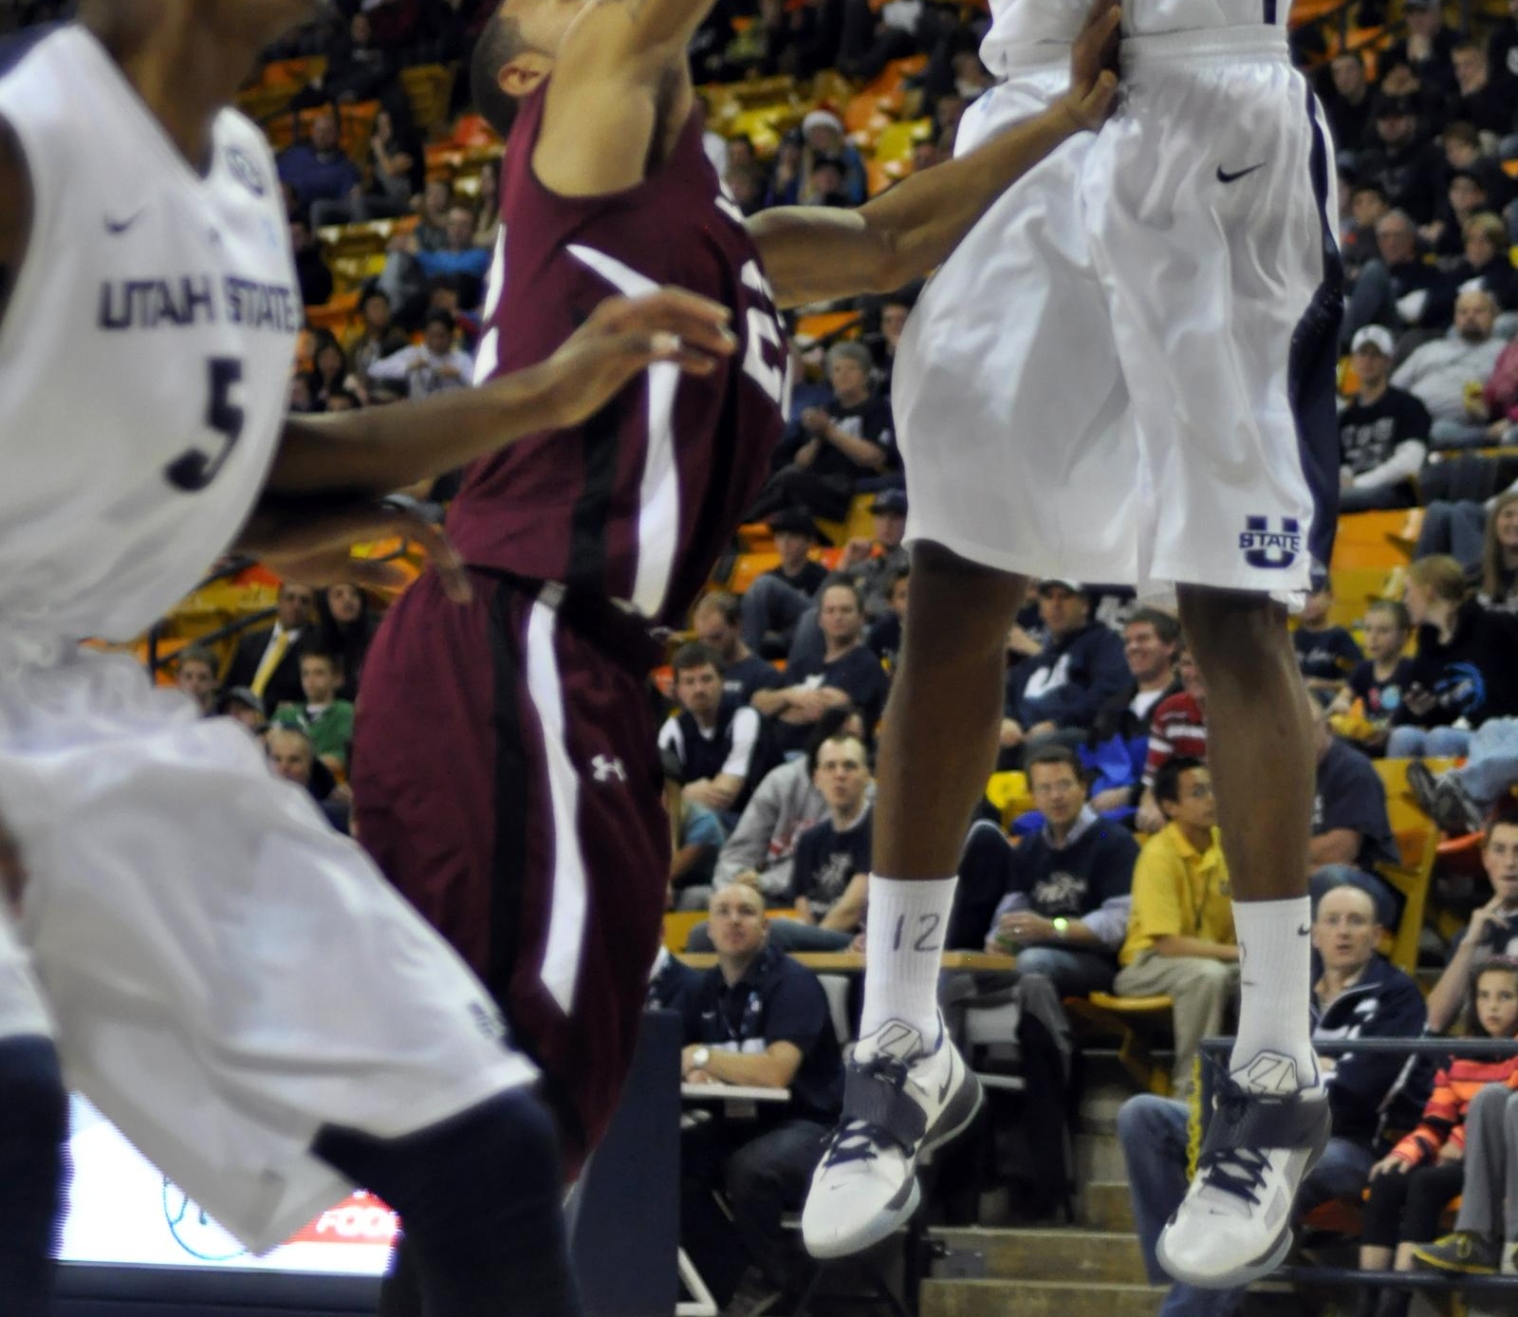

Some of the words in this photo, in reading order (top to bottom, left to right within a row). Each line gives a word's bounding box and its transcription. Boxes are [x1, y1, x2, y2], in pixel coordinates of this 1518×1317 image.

[98, 275, 212, 330] UTAH
[224, 275, 303, 330] STATE
[163, 355, 244, 492] 5
[1238, 531, 1301, 553] STATE
[892, 912, 940, 952] 12
